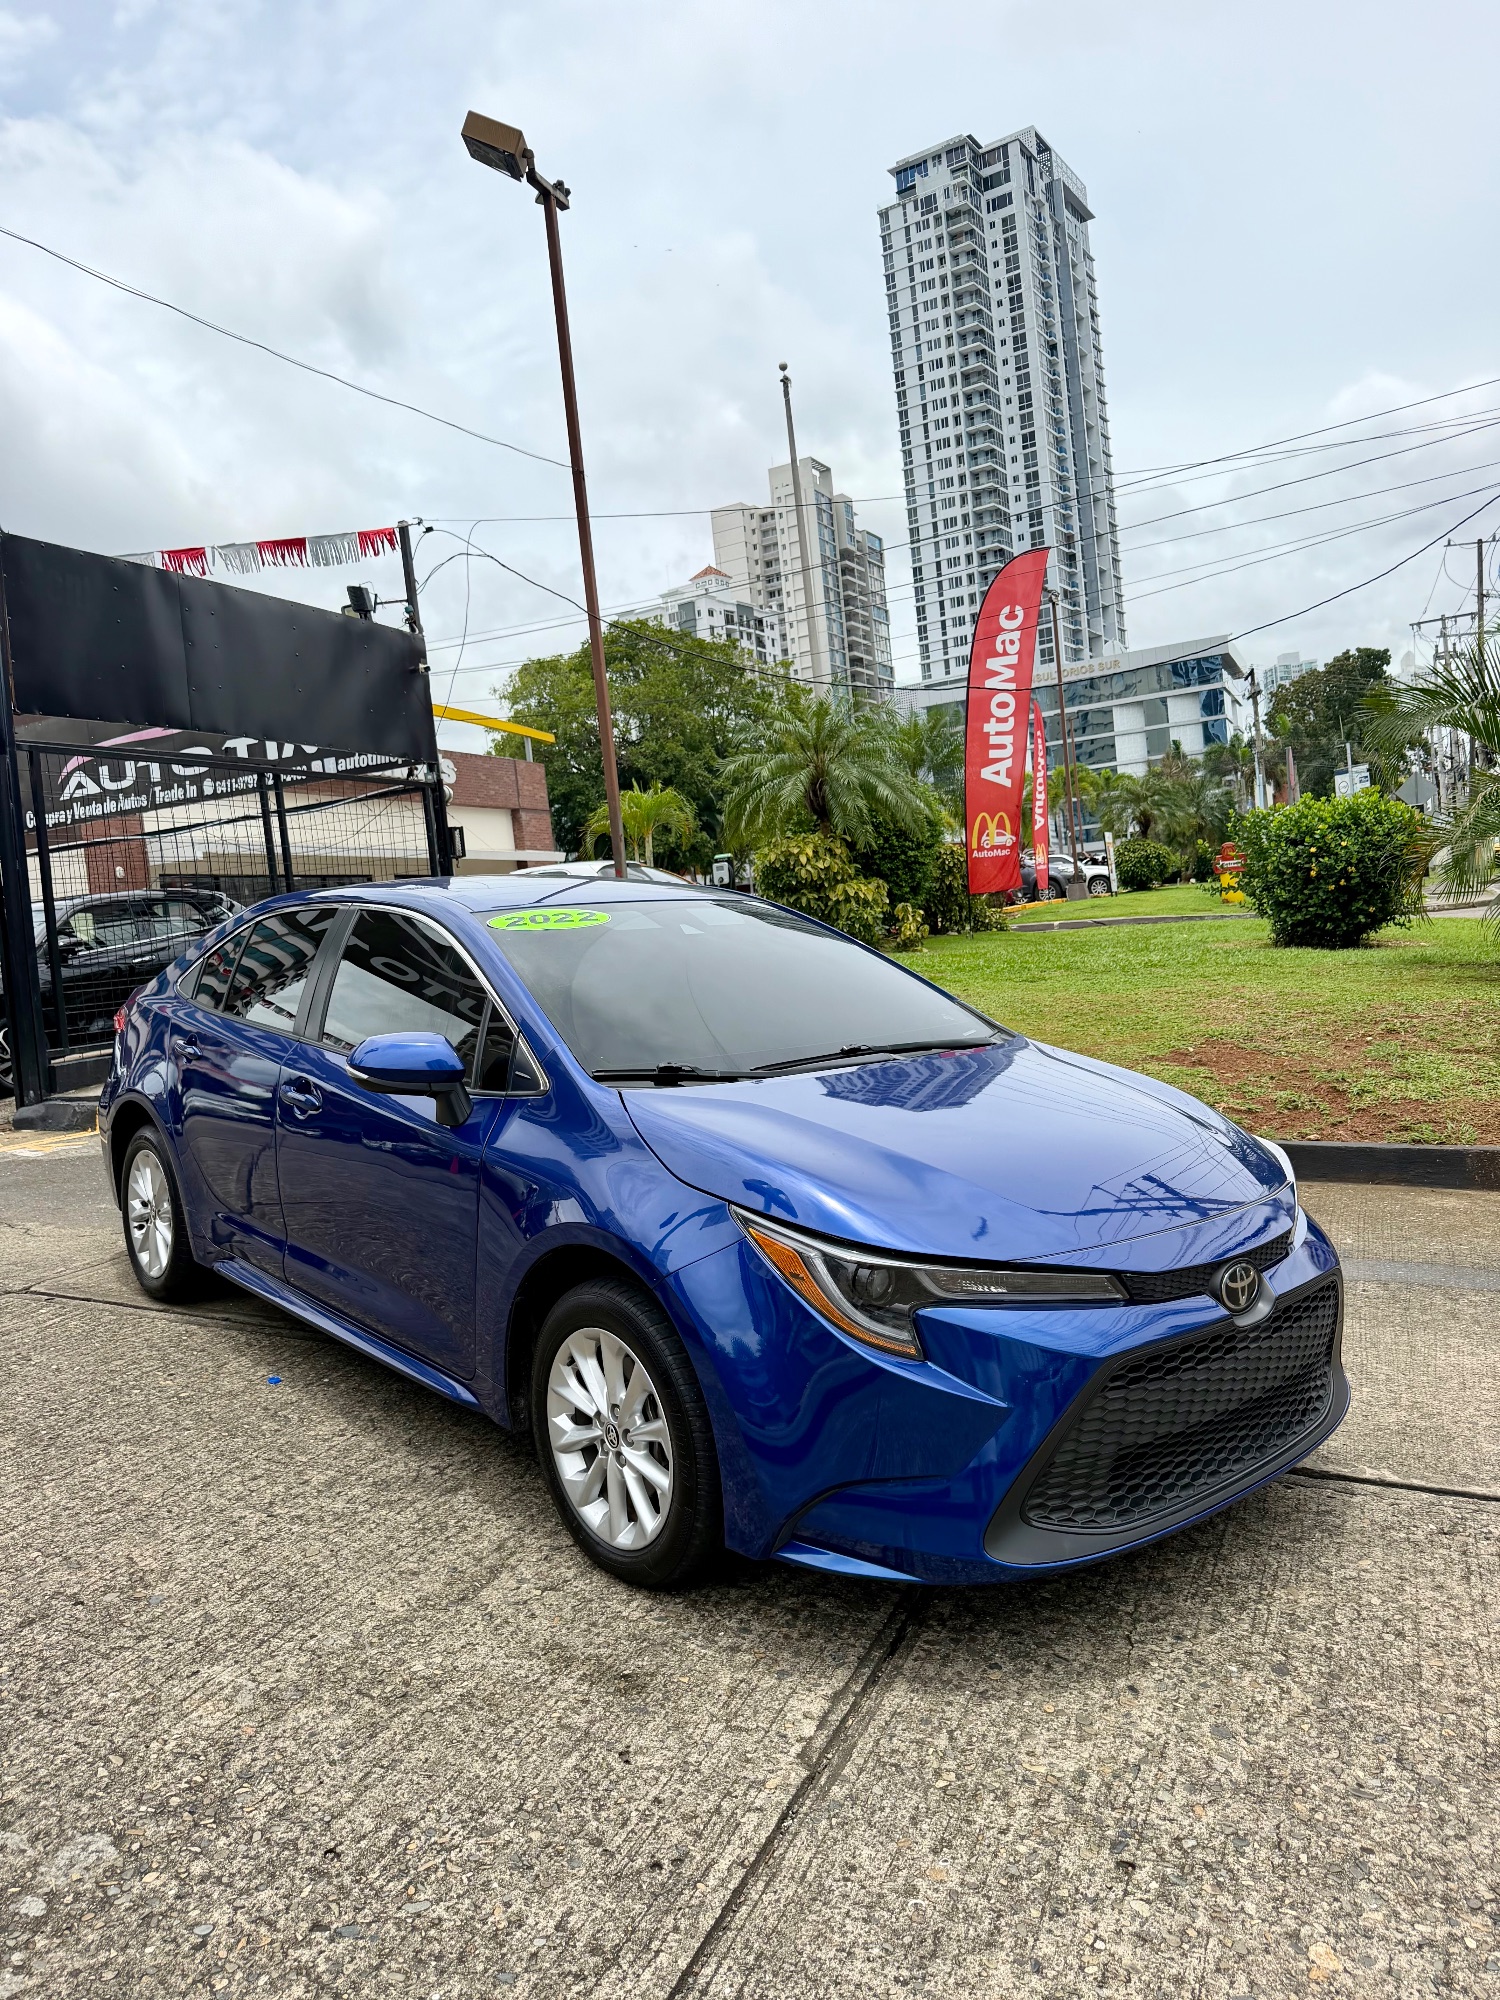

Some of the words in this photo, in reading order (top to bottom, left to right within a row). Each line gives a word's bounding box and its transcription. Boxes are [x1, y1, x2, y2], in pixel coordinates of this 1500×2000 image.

[1098, 659, 1121, 672] SUR
[981, 604, 1024, 788] AutoMac
[26, 809, 66, 828] Cpra
[66, 808, 73, 824] y
[73, 801, 102, 819] Venta
[104, 796, 116, 814] de
[118, 793, 147, 812] Autos
[154, 783, 184, 804] Trade
[186, 781, 197, 799] in
[972, 849, 1010, 858] AutoMac
[506, 911, 599, 928] 2022
